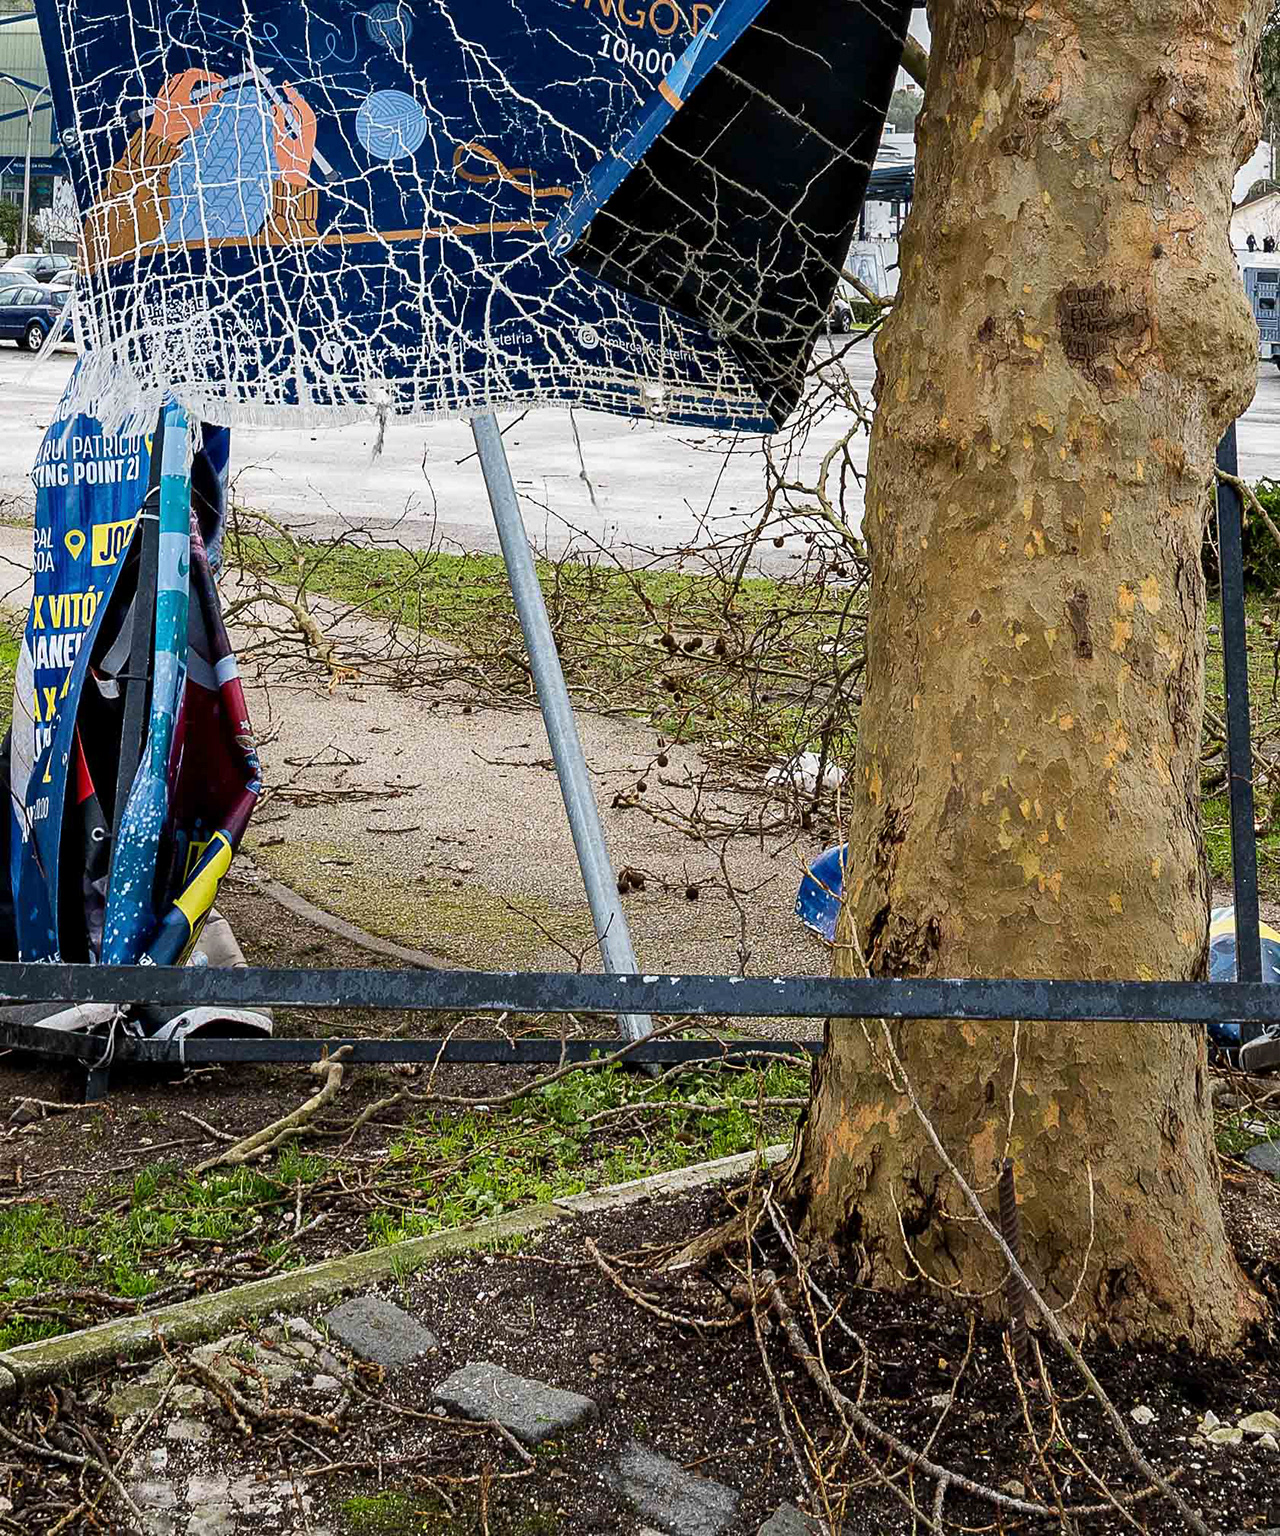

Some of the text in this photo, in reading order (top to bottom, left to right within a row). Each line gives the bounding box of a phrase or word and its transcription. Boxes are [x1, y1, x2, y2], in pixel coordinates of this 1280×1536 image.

[596, 32, 677, 77] 10h00
[224, 318, 264, 332] SABA
[42, 437, 67, 463] RUI
[73, 459, 125, 485] POINT
